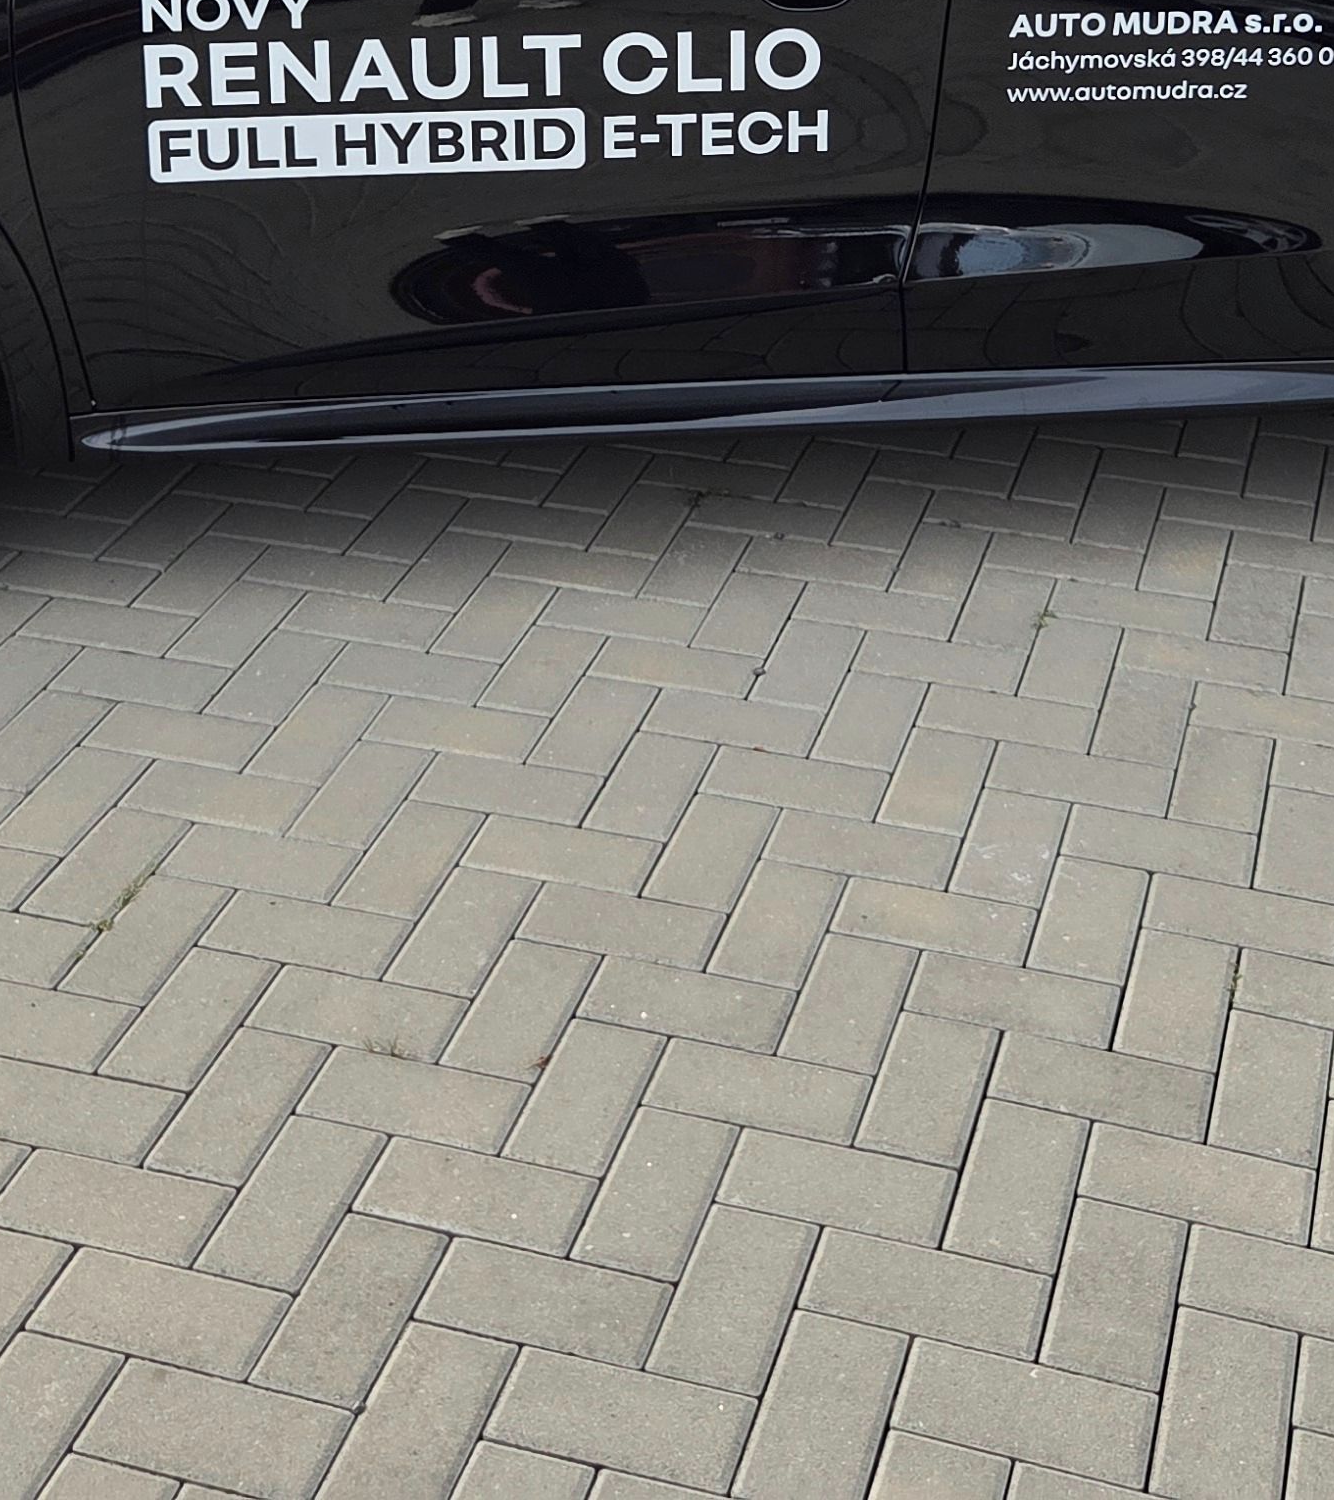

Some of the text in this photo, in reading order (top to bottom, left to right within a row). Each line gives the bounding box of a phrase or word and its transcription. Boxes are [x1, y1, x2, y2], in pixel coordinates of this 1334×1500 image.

[1008, 9, 1323, 38] AUTO MUDRA s.r.o.
[144, 28, 821, 109] RENAULT CLIO
[1007, 47, 1176, 74] Jáchymovská
[1181, 47, 1264, 70] 398/44
[1267, 46, 1313, 66] 360
[1006, 79, 1248, 103] www.automudra.cz
[159, 109, 829, 173] FULL HYBRID E-TECH
